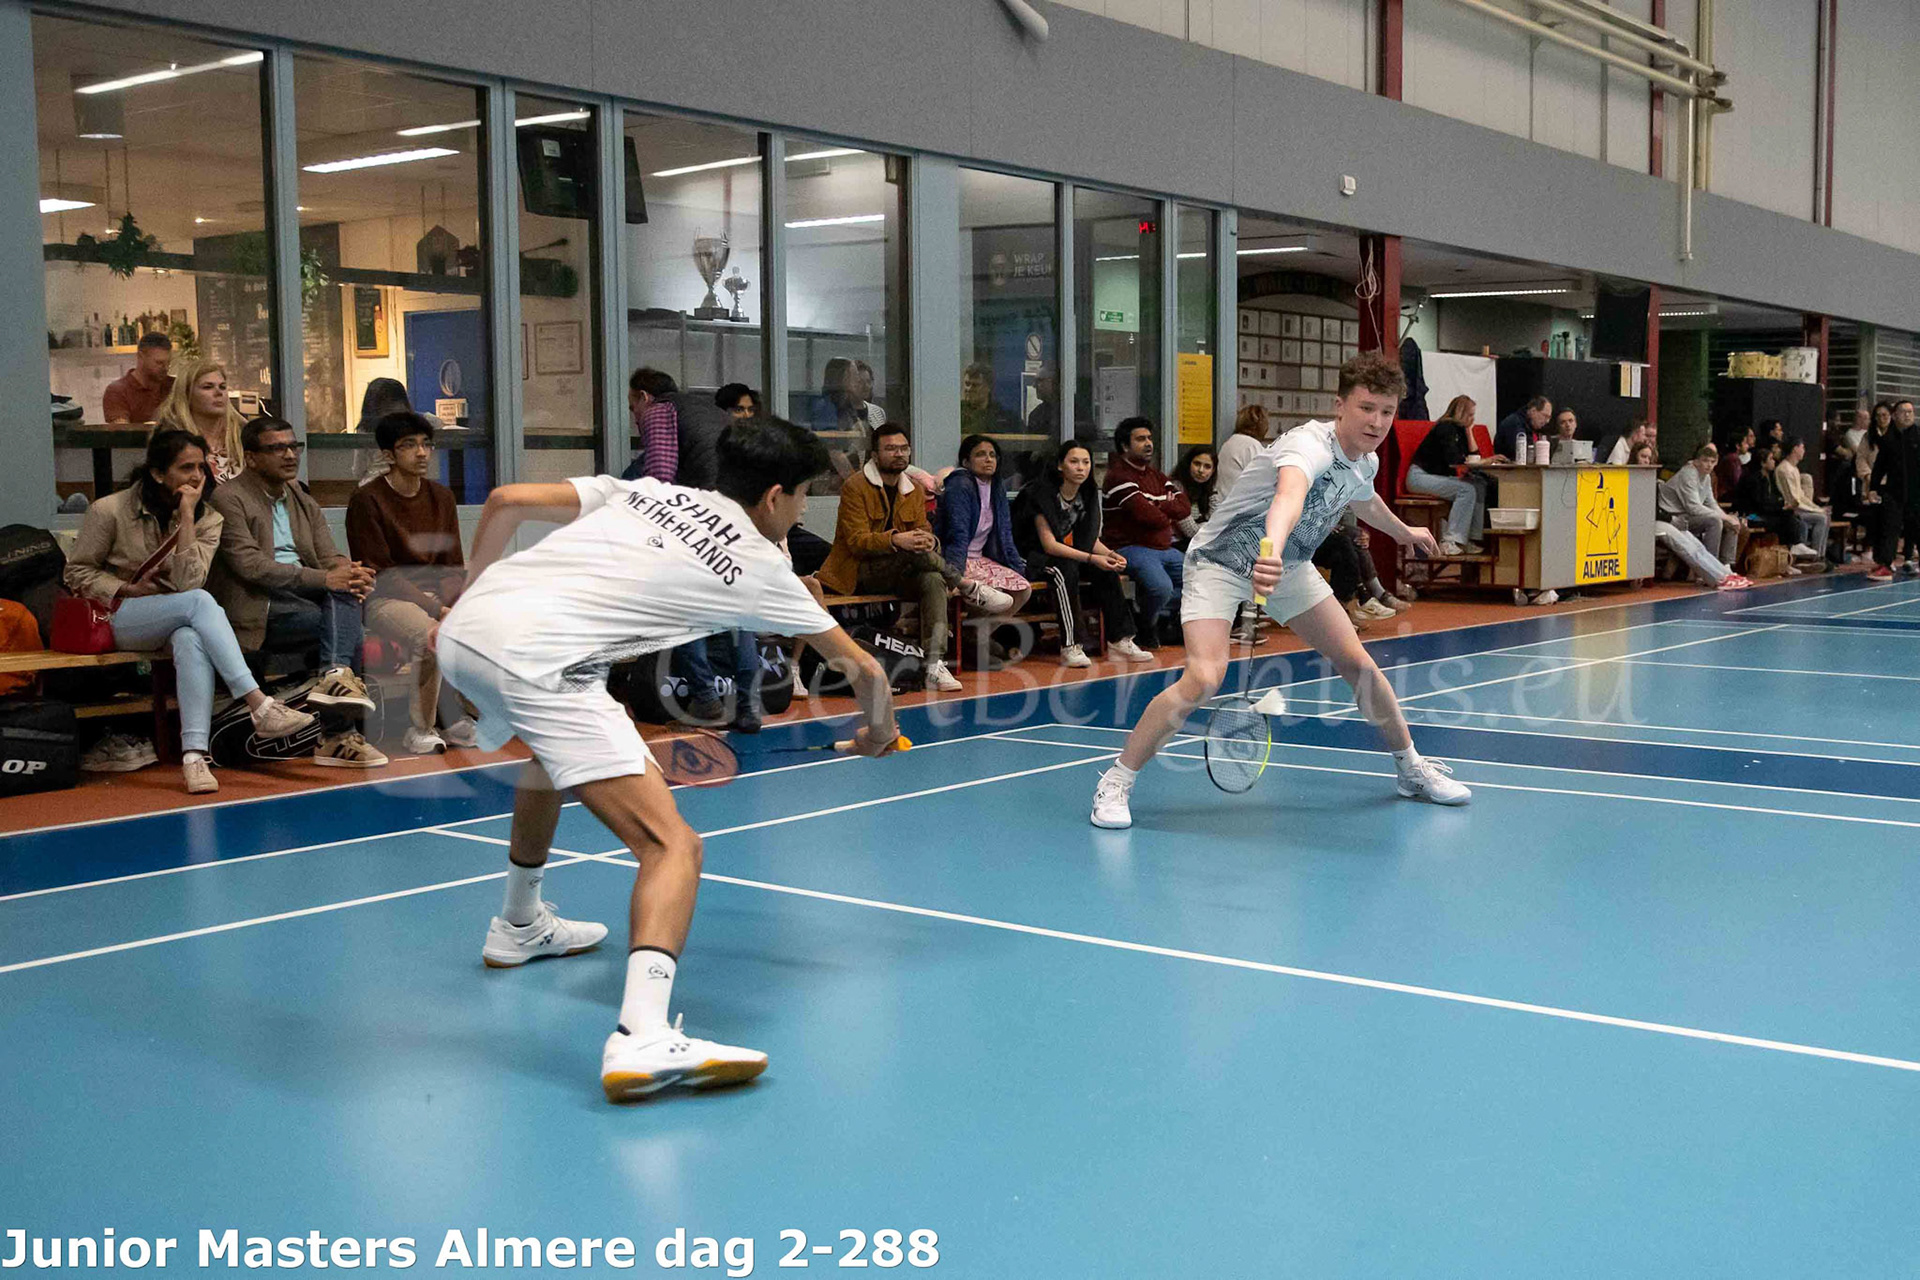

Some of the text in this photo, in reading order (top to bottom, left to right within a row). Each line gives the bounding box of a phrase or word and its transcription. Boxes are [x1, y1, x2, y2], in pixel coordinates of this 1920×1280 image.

[1013, 253, 1044, 264] WRAP
[666, 493, 741, 546] SHAH
[624, 491, 743, 586] NETHERLANDS
[1582, 558, 1620, 579] ALMERE
[2, 759, 47, 775] OP
